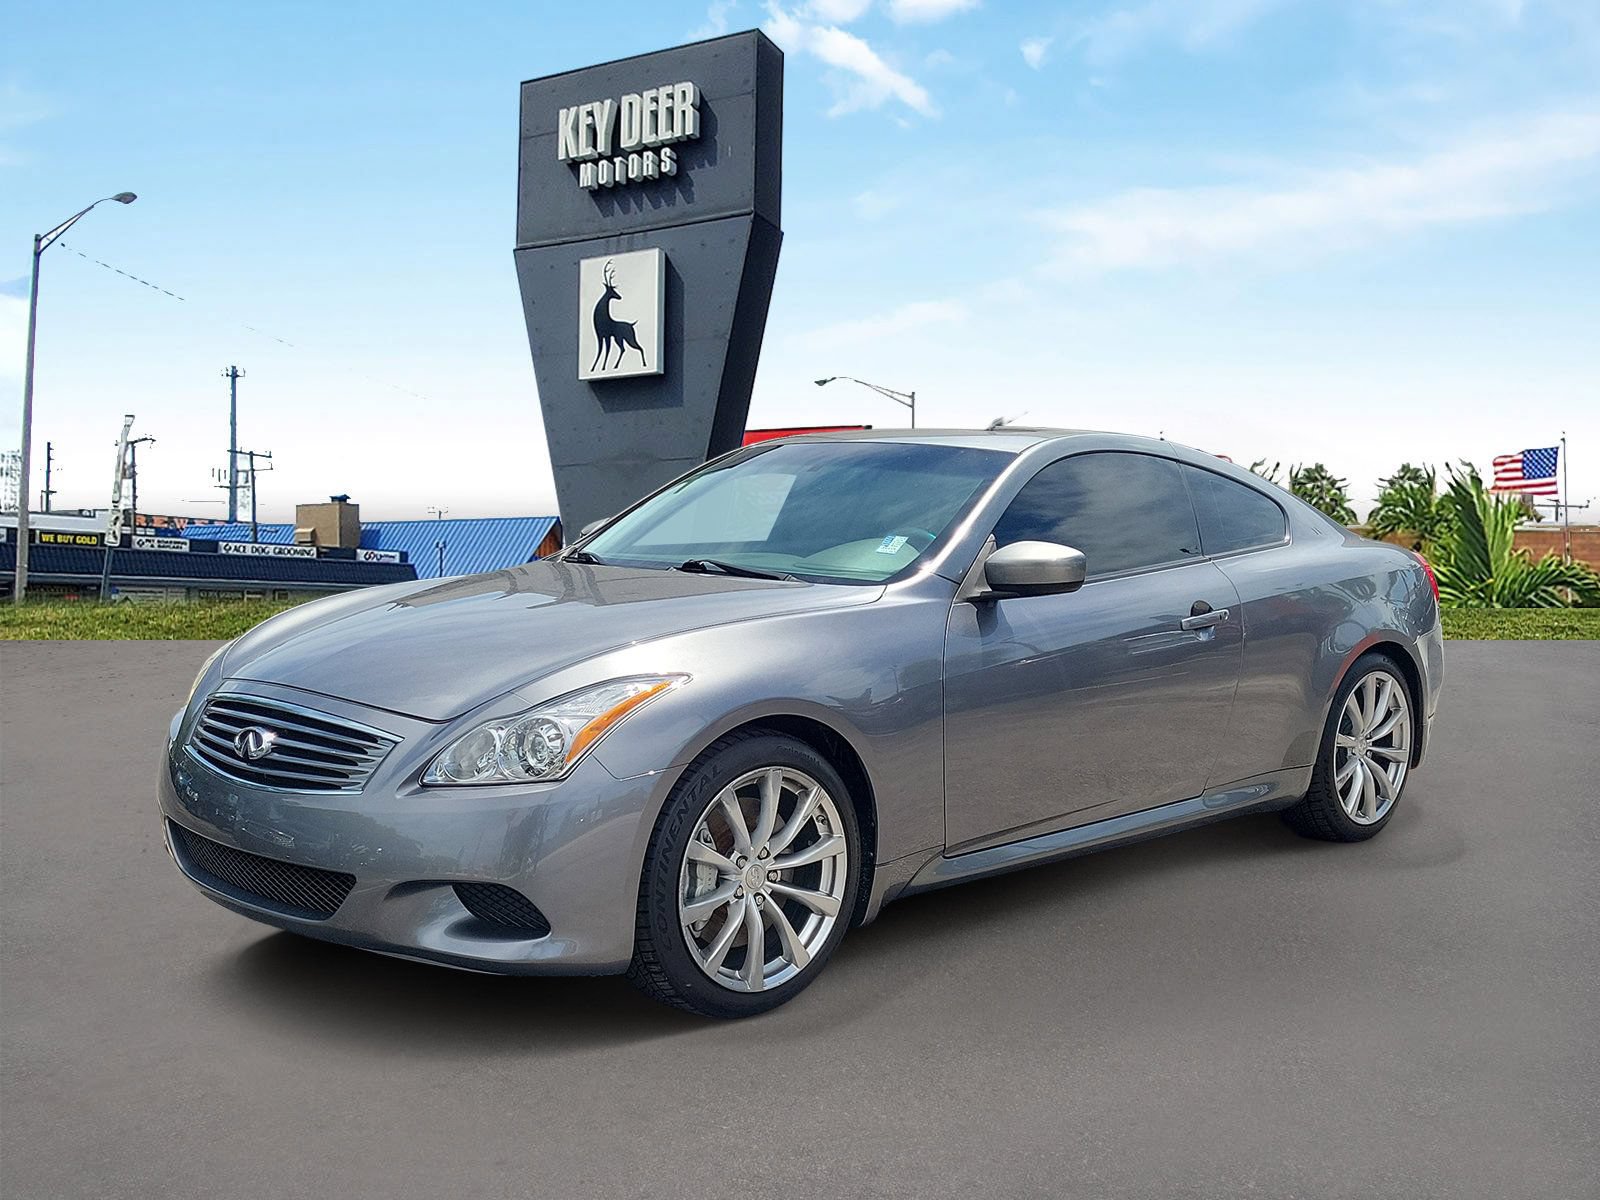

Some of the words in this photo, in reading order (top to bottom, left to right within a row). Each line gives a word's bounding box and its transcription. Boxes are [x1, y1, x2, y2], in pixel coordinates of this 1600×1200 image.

[557, 98, 617, 164] KEY
[620, 81, 700, 152] DEER
[579, 147, 677, 190] MOTORS
[41, 533, 55, 543] WE
[57, 534, 74, 544] BUY
[76, 535, 98, 545] GOLD
[232, 544, 247, 554] ACE
[250, 545, 270, 555] DOG
[273, 547, 315, 557] GROOMING
